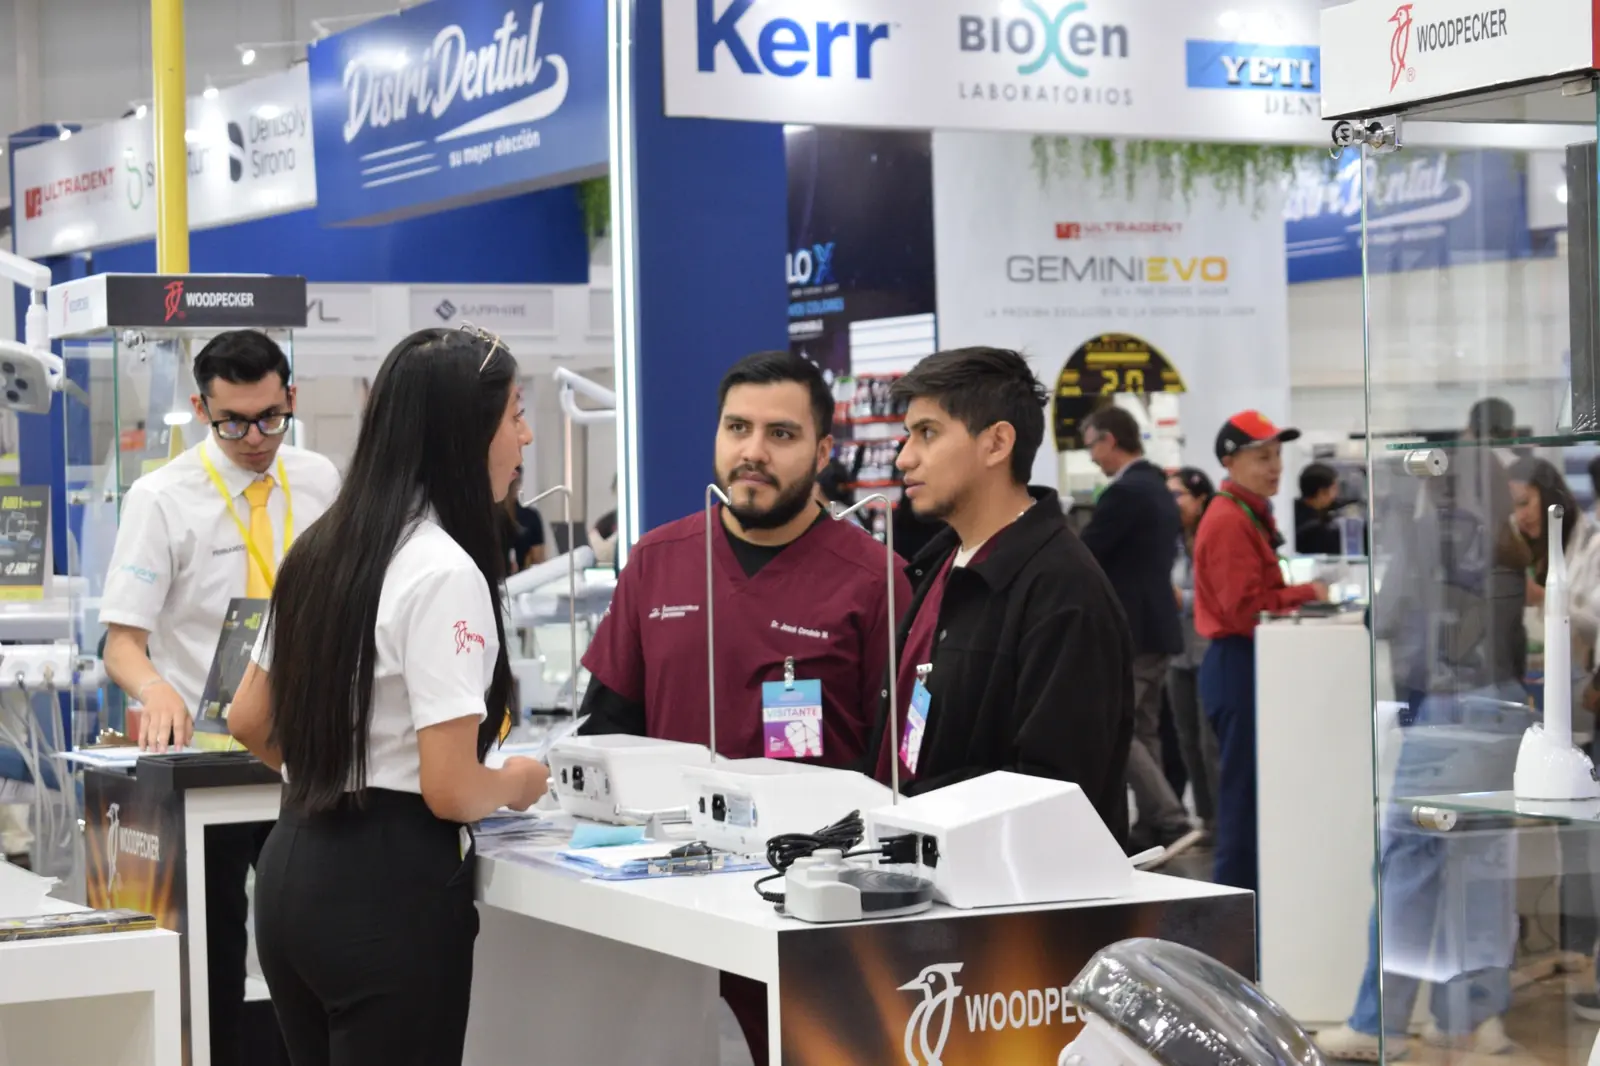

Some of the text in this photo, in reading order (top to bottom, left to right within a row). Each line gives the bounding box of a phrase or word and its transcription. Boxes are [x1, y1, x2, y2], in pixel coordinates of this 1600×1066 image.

[696, 0, 889, 79] Kerr
[1417, 8, 1508, 53] WOODPECKER
[1221, 55, 1314, 87] YETI
[958, 82, 1134, 106] LABORATORIOS
[249, 103, 308, 144] Dentsply
[252, 147, 296, 178] Sirona
[463, 142, 493, 165] mejor
[495, 128, 541, 157] elección
[45, 167, 115, 201] ULTRADENT
[1083, 221, 1183, 233] ULTRADENT
[185, 292, 254, 308] WOODPECKER
[767, 707, 818, 718] VISITANTE
[118, 826, 161, 862] WOODPECKER
